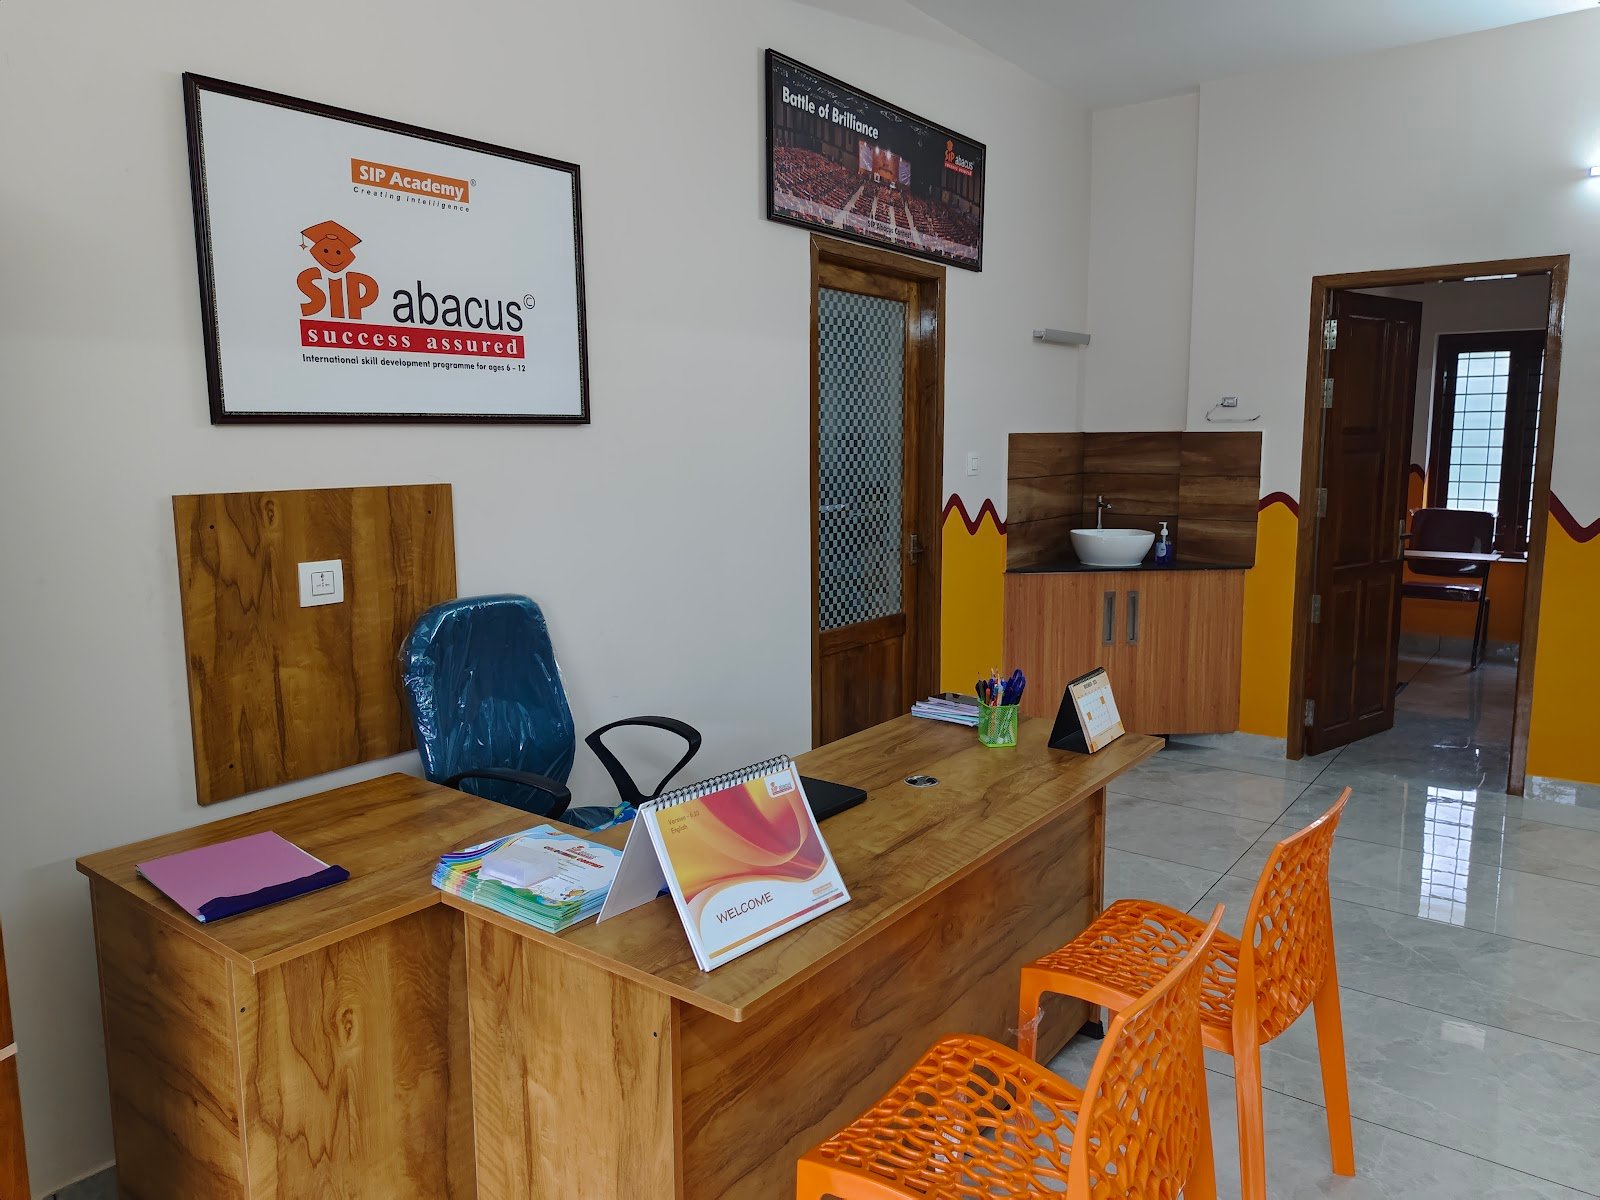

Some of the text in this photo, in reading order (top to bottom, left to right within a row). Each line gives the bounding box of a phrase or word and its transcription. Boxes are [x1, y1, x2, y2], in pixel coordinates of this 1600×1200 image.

[782, 85, 879, 140] Battle of Brilliance
[353, 186, 401, 202] Creating
[359, 165, 465, 201] SIP Academy
[307, 328, 518, 355] success assured
[302, 353, 359, 365] International
[361, 356, 378, 365] skill
[380, 357, 431, 369] development
[432, 361, 475, 371] programme
[476, 362, 487, 370] for
[488, 364, 505, 373] ages
[506, 364, 511, 372] 6
[518, 364, 526, 372] 12
[715, 891, 774, 924] WELCOME
